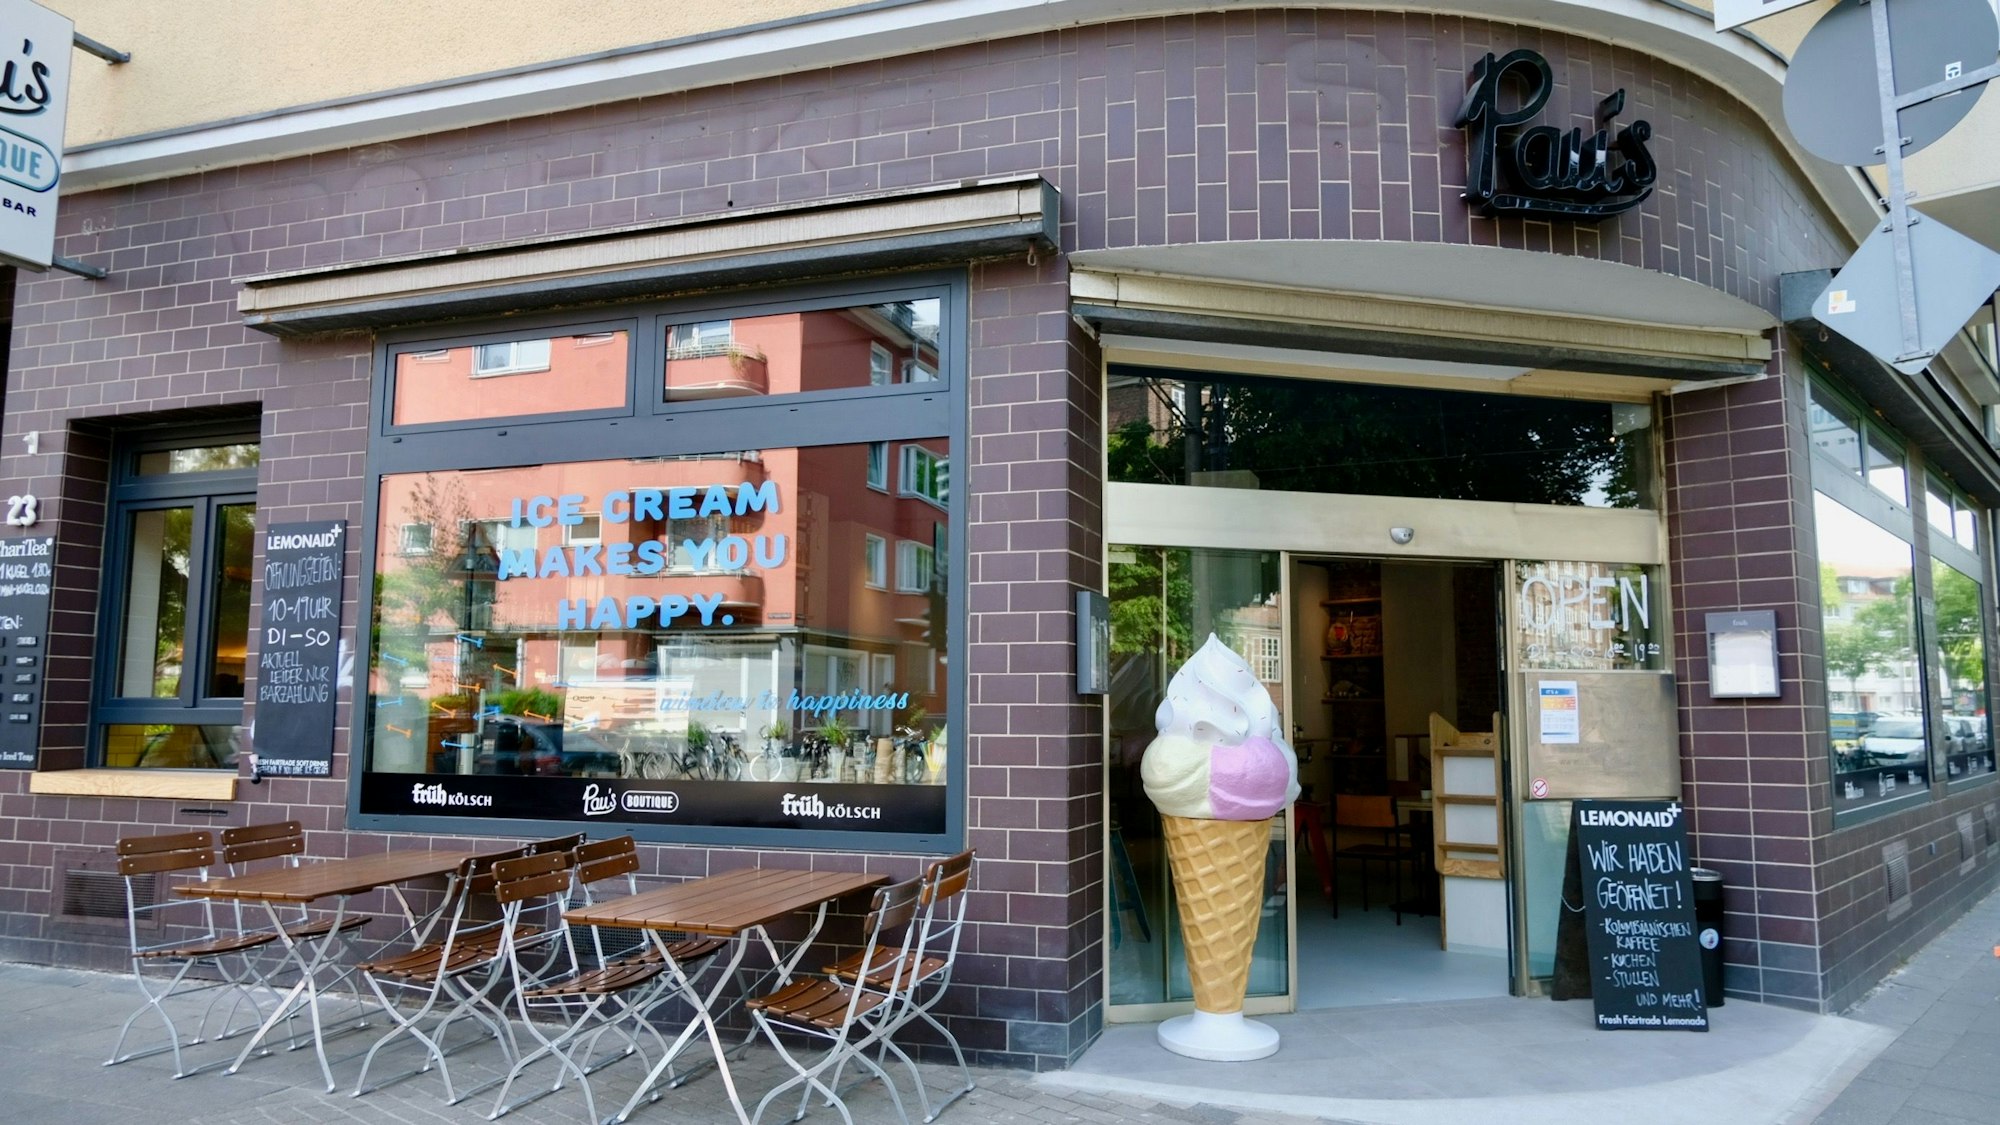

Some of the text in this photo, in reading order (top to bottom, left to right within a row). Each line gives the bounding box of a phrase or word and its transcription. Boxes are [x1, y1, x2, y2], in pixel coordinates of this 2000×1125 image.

[1455, 48, 1657, 216] Pau's
[3, 197, 37, 218] BAR
[22, 430, 39, 455] 1
[7, 494, 37, 527] 23
[511, 480, 780, 529] ICE CREAM
[0, 538, 53, 558] hariTea
[497, 533, 786, 581] MAKES YOU
[557, 592, 735, 632] HAPPY.
[1521, 574, 1650, 632] OPEN
[261, 650, 303, 668] AKTUELL
[306, 665, 330, 682] NUR
[260, 684, 329, 704] BARZAHLUNG
[786, 687, 910, 720] happiness
[448, 792, 492, 807] KÖLSCH
[582, 783, 674, 816] Pau's BOUTIQUE
[826, 803, 881, 820] KÖLSCH
[1628, 840, 1682, 874] HABEN
[1616, 936, 1661, 953] KAFFEE
[1636, 988, 1702, 1011] UND MEHR!
[1599, 1014, 1706, 1026] Fresh Fairtrade Lemonade
